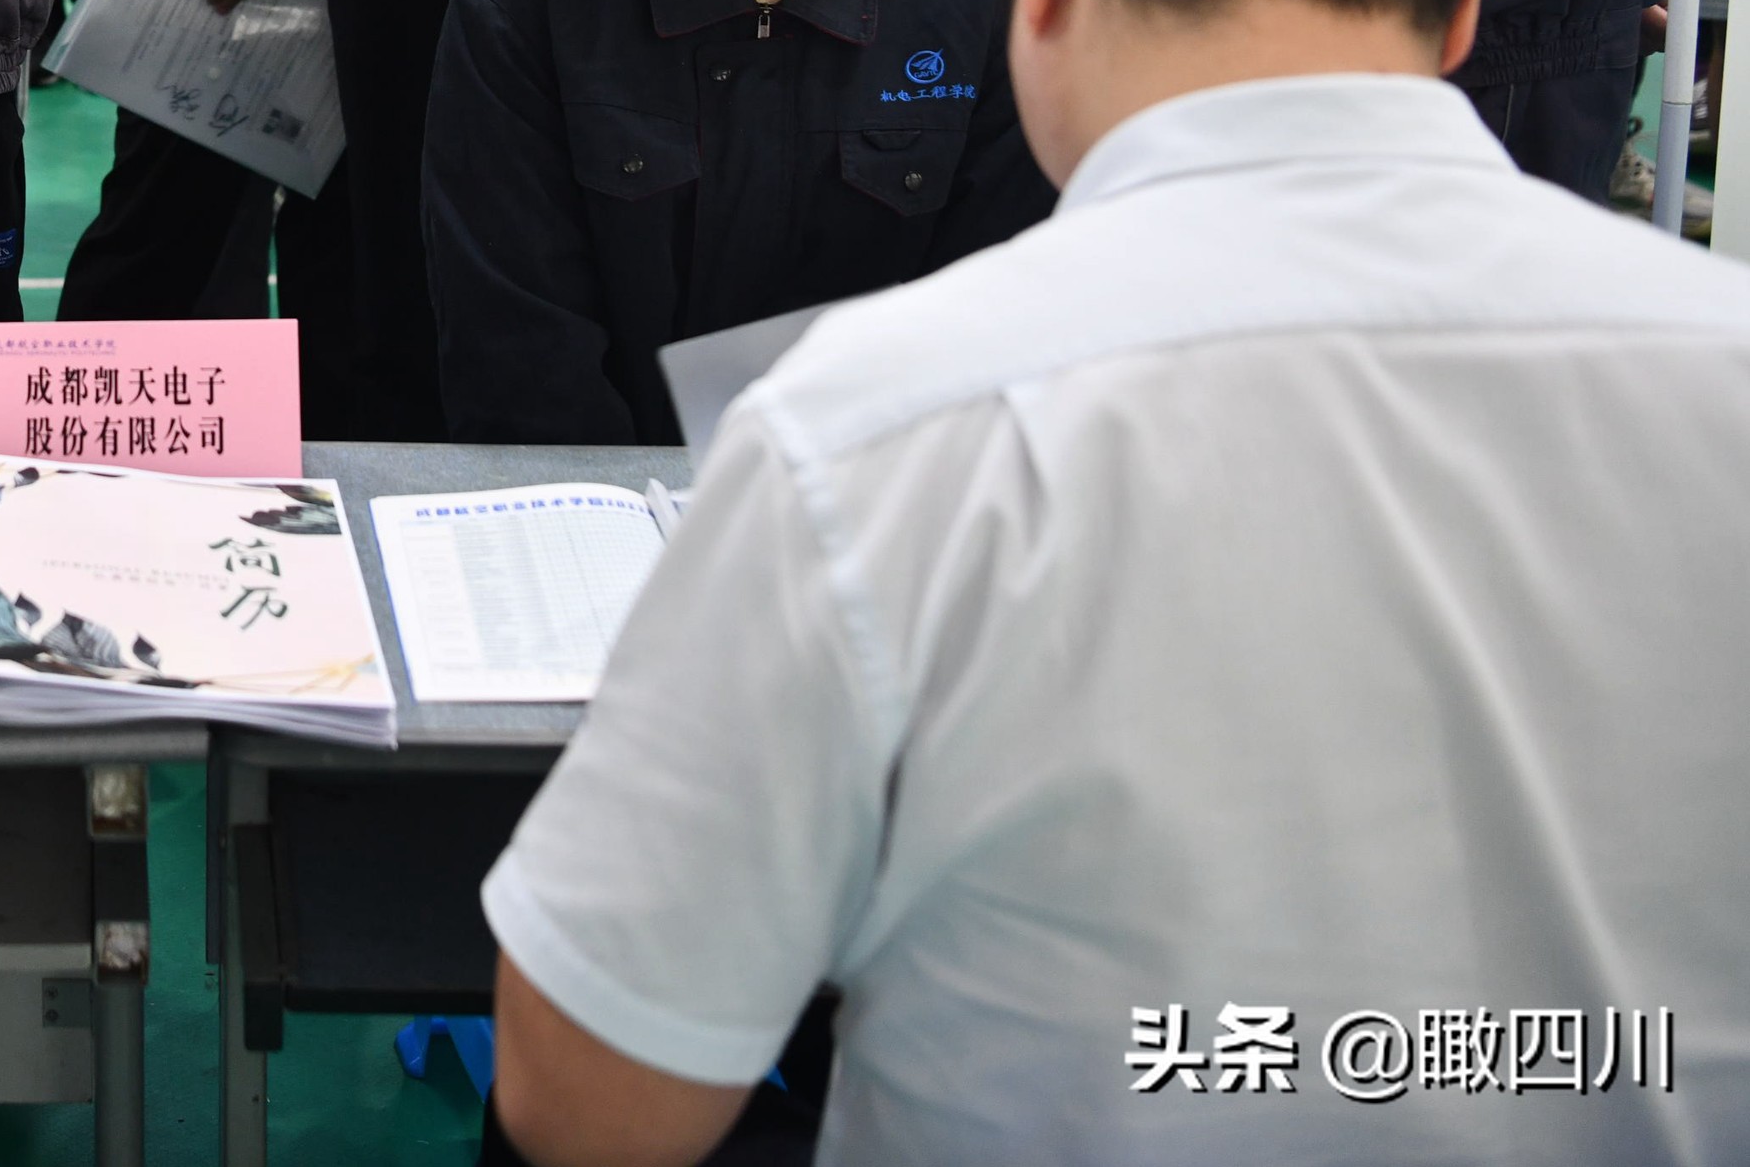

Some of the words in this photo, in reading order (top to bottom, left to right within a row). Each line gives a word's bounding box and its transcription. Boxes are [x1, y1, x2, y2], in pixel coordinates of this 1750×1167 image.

[880, 84, 975, 102] 机电工程学院
[25, 365, 227, 407] 成都凯天电子
[25, 415, 226, 457] 股份有限公司
[208, 536, 289, 631] 简历
